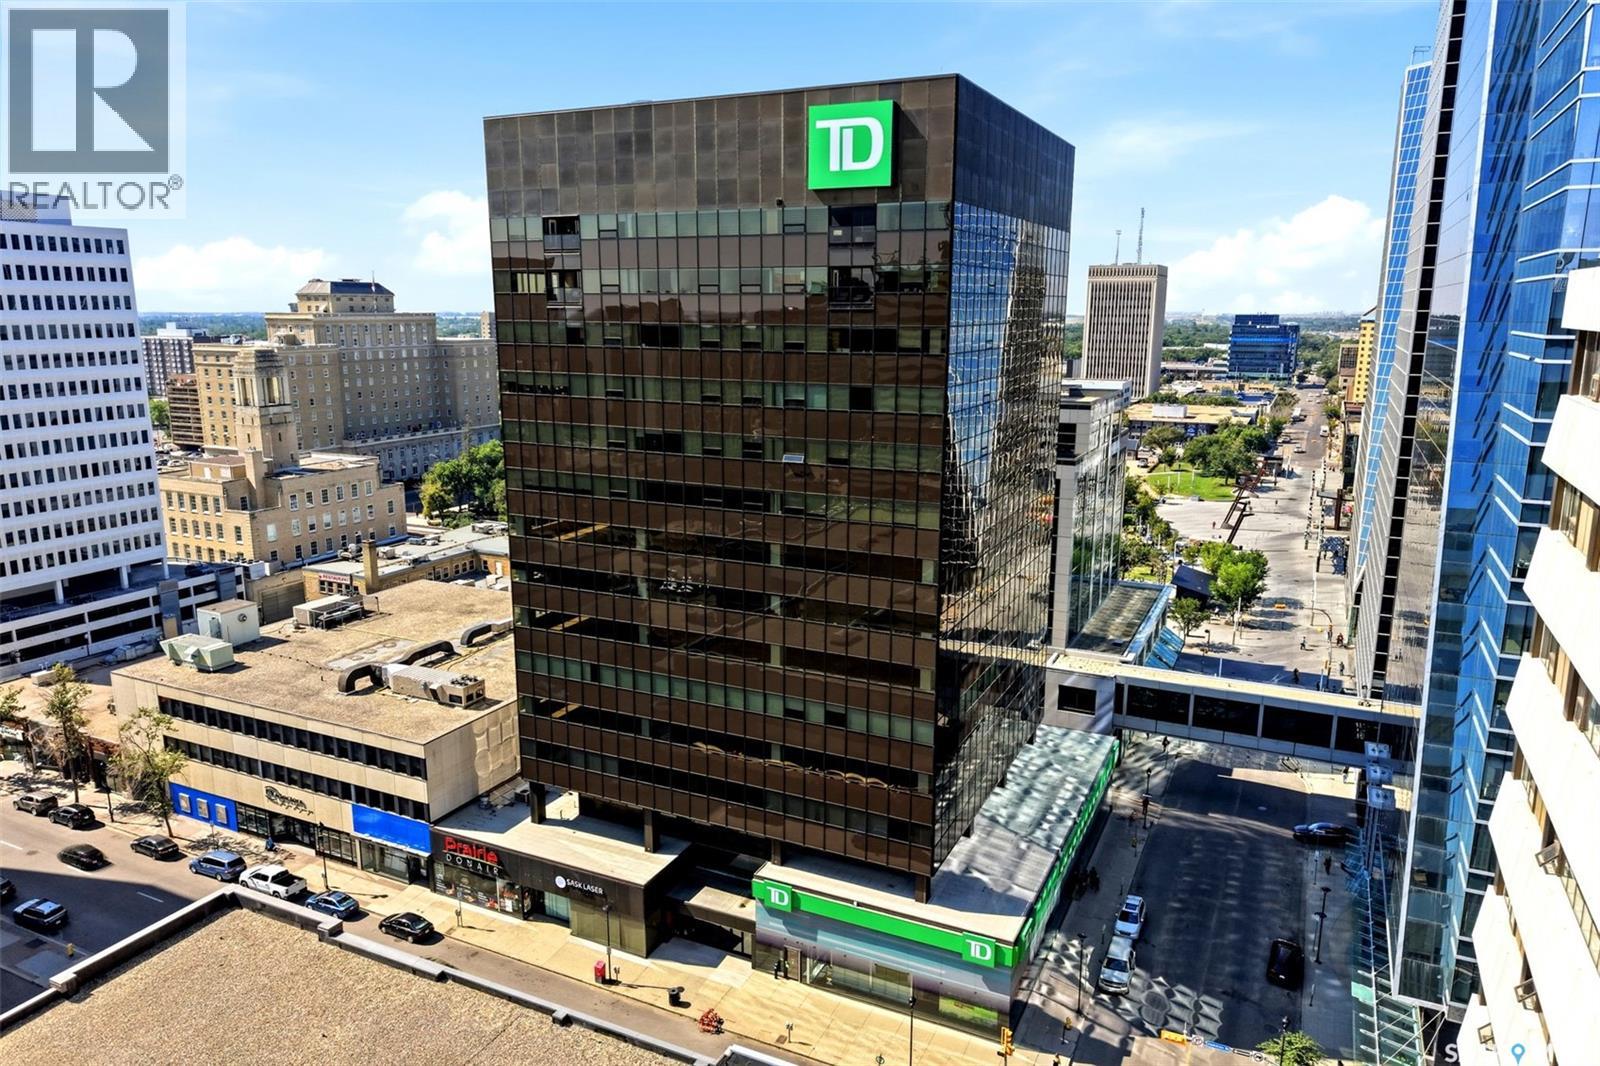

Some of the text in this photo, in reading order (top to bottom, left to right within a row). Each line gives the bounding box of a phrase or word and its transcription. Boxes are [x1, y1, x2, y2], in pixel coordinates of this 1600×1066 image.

[815, 117, 884, 172] TD
[444, 837, 497, 863] Prairie
[446, 854, 498, 875] DONAIR
[566, 878, 603, 895] SASK LASER
[766, 887, 789, 906] TD
[967, 940, 992, 961] TD
